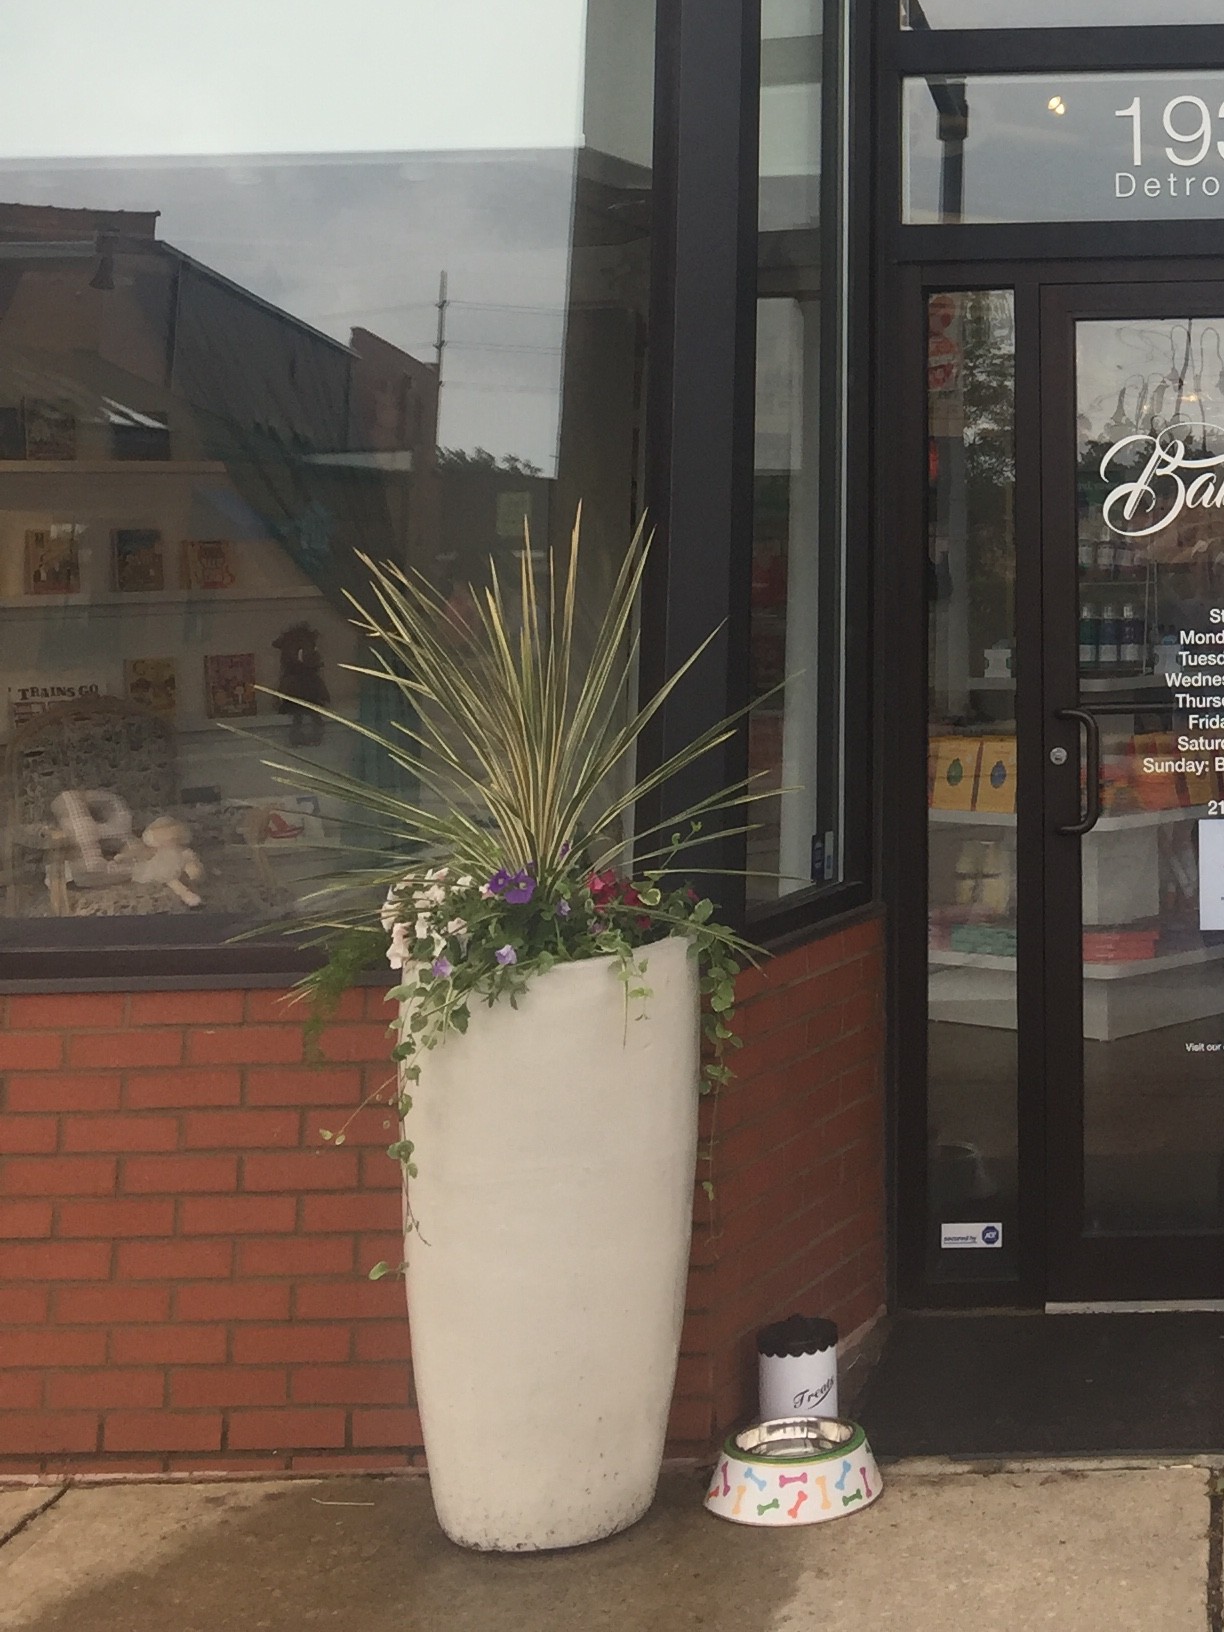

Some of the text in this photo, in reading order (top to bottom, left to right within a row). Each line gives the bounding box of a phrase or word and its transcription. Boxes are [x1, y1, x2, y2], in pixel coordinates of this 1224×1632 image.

[17, 685, 76, 701] TRAINS
[1142, 757, 1210, 777] Sunday:
[1185, 1042, 1205, 1052] Visit
[1206, 1043, 1221, 1052] our
[792, 1375, 835, 1410] Treats
